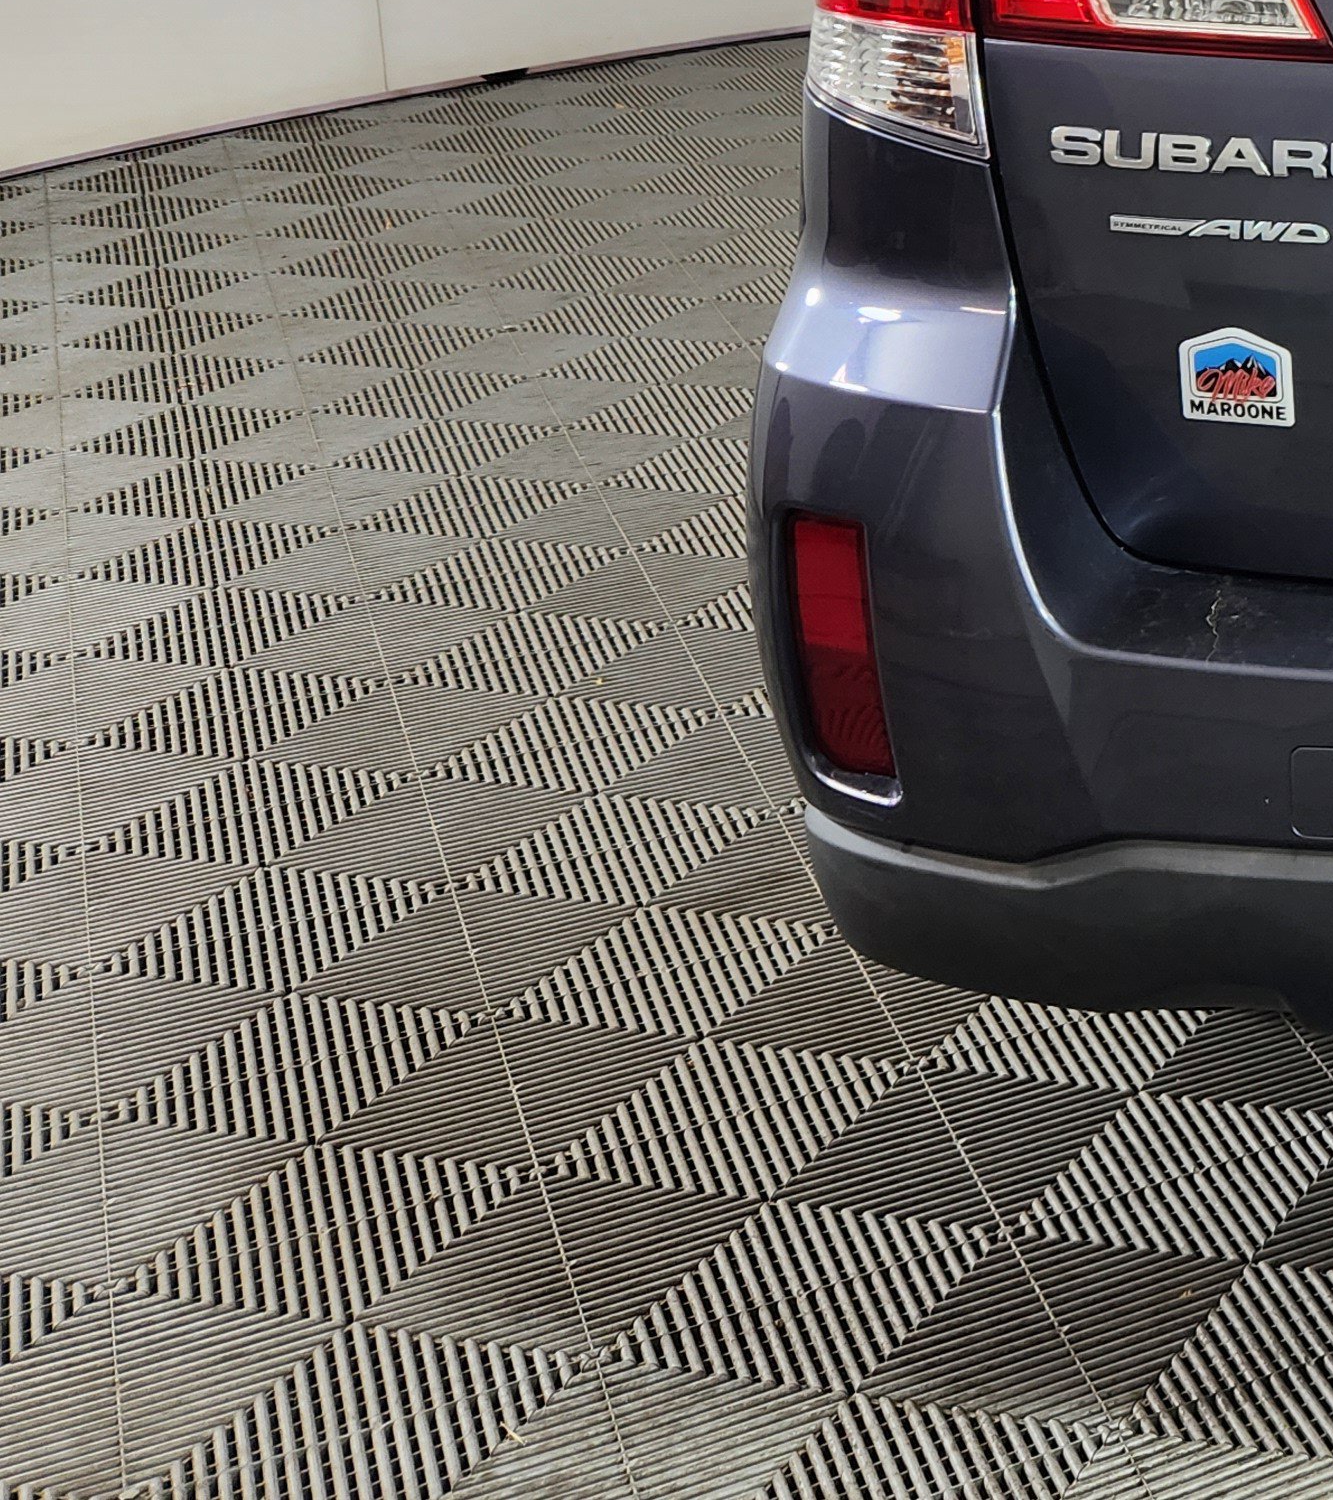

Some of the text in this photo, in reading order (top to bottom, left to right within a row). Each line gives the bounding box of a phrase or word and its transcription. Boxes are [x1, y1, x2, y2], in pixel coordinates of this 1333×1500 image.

[1188, 218, 1331, 244] AWD
[1197, 367, 1276, 404] Mike
[1189, 399, 1287, 421] MAROONE
